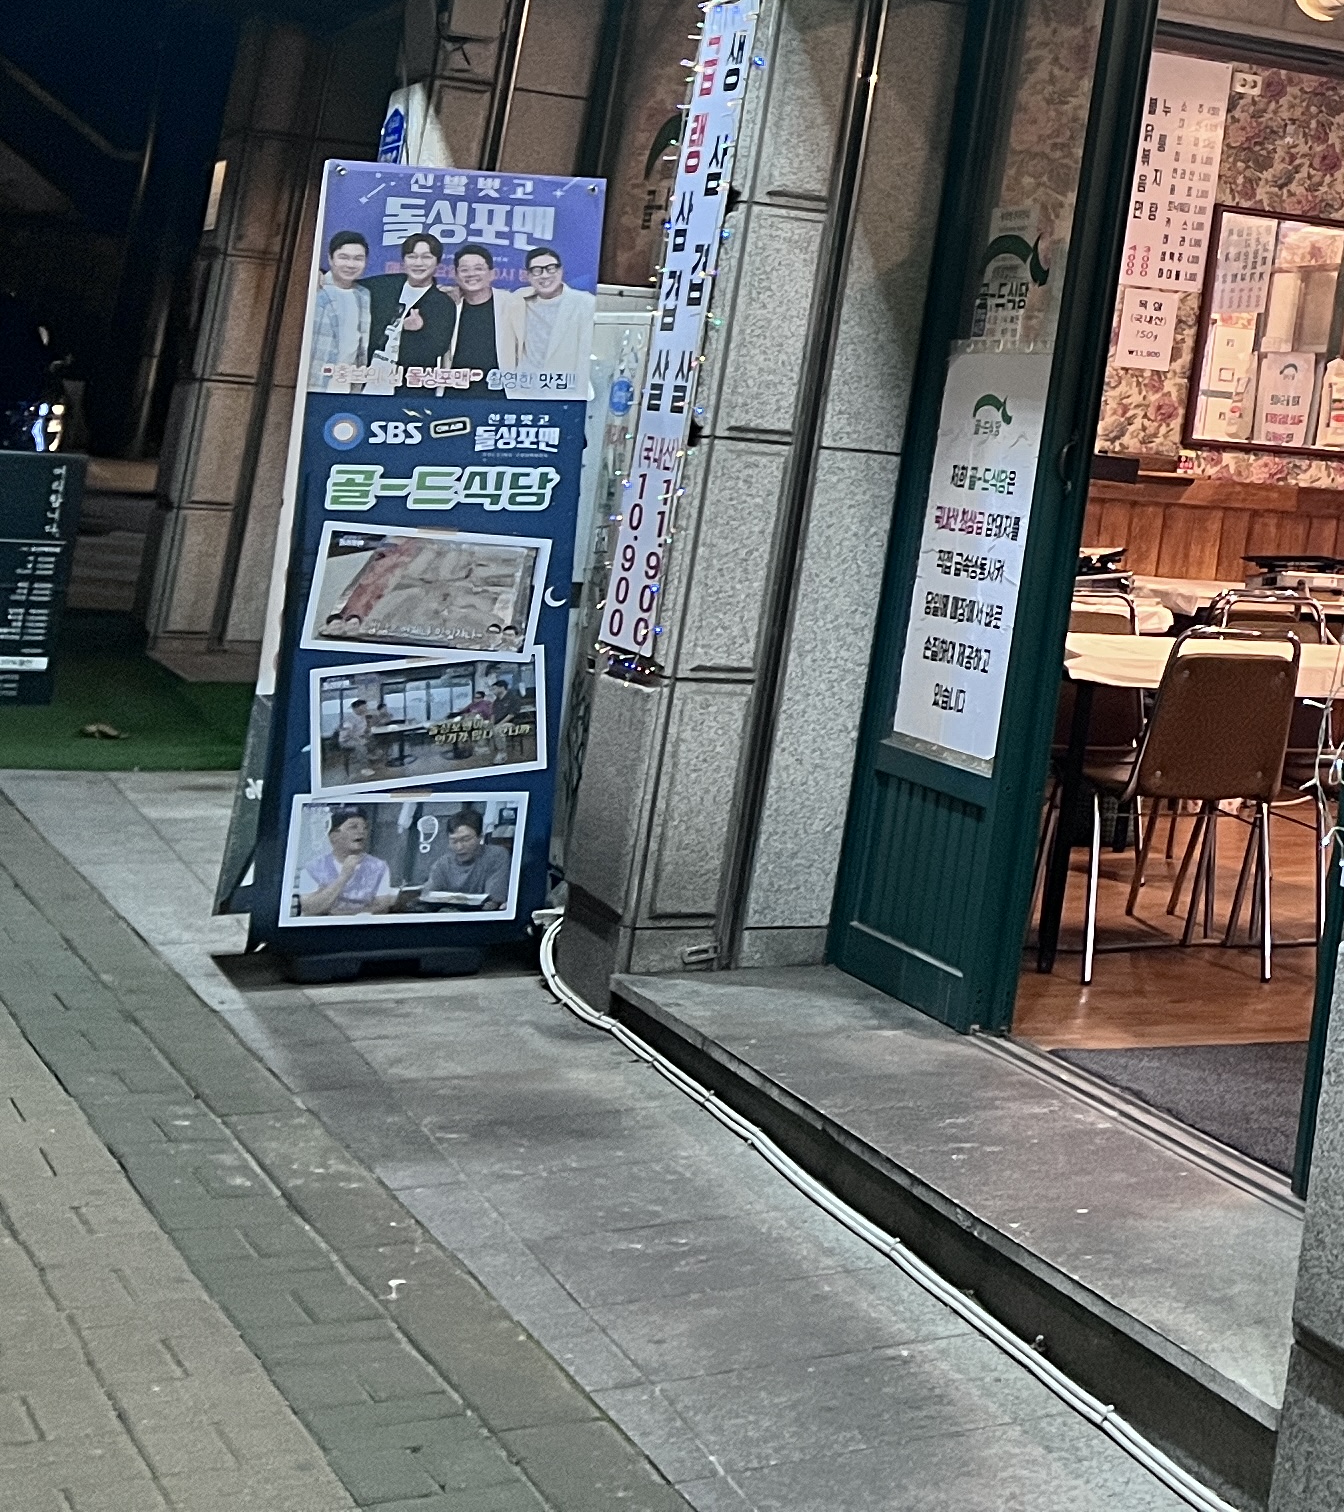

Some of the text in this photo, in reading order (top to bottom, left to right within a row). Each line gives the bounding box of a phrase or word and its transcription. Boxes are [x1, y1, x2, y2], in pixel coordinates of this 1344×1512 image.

[382, 196, 556, 252] 돌싱포맨
[369, 421, 423, 445] SBS
[474, 426, 561, 453] 돌싱포맨
